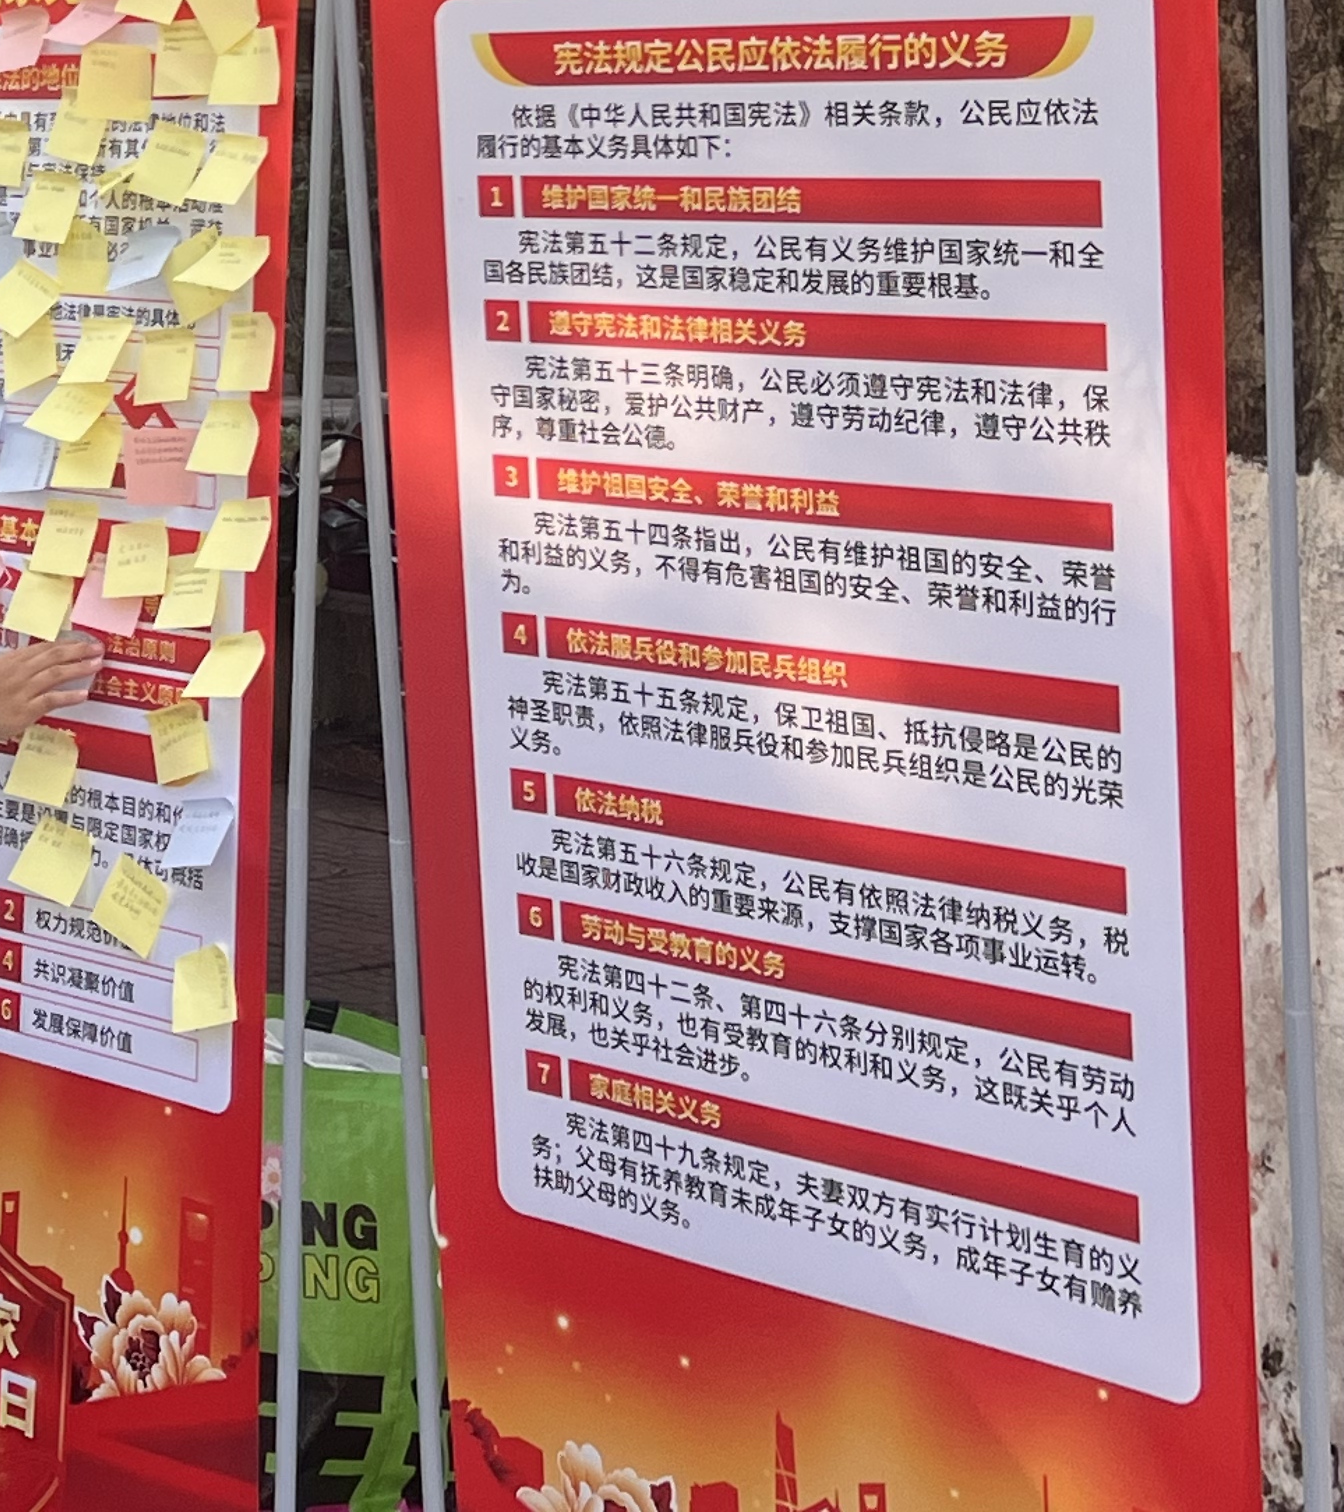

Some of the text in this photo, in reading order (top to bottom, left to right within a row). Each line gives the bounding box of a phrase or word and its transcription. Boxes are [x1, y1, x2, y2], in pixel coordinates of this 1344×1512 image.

[553, 30, 1009, 76] 宪法规定公民应依法履行的义务
[511, 97, 1100, 129] 依据《中华人民共和国宪法》相关条款，公民应依法
[475, 132, 734, 161] 履行的基本义务具体如下：
[489, 184, 802, 215] 1 维护国家统一和民族团结
[483, 259, 993, 301] 国各民族团结，这是国家稳定和发展的重要根基。
[517, 228, 1106, 271] 宪法第五十二条规定，公民有义务维护国家统一和全
[495, 310, 808, 348] 2 遵守宪法和法律相关义务
[524, 353, 1111, 413] 宪法第五十三条明确，公民必须遵守宪法和法律，保
[490, 383, 1111, 449] 守国家秘密，爱护公共财产，遵守劳动纪律，遵守公共秩
[490, 413, 677, 452] 序，尊重社会公德。
[504, 464, 840, 516] 3 维护祖国安全、荣誉和利益
[497, 537, 1116, 628] 和利益的义务，不得有危害祖国的安全、荣誉和利益的行
[500, 565, 534, 597] 为。
[533, 511, 1116, 593] 宪法第五十四条指出，公民有维护祖国的安全、荣誉
[512, 624, 849, 689] 4 依法服兵役和参加民兵组织
[507, 694, 1125, 809] 神圣职责，依照法律服兵役和参加民兵组织是公民的光荣
[509, 725, 565, 760] 义务。
[542, 669, 1122, 775] 宪法第五十五条规定，保卫祖国、抵抗侵略是公民的
[520, 779, 664, 827] 5 依法纳税
[3, 899, 16, 922] 2
[515, 851, 1099, 986] 收是国家财政收入的重要来源，支撑国家各项事业运转。
[550, 827, 1130, 960] 宪法第五十六条规定，公民有依照法律纳税义务，税
[527, 904, 786, 980] 6 劳动与受教育的义务
[1, 949, 135, 1004] 4 共识凝聚价值
[0, 998, 133, 1056] 6 发展保障价值
[523, 1008, 753, 1084] 发展，也关乎社会进步。
[556, 953, 1136, 1103] 宪法第四十二条、第四十六条分别规定，公民有劳动
[522, 978, 1137, 1139] 的权利和义务，也有受教育的权利和义务，这既关乎个人
[535, 1061, 723, 1130] 7 家庭相关义务
[531, 1132, 1143, 1319] 务；父母有抚养教育未成年子女的义务，成年子女有赡养
[532, 1165, 693, 1231] 扶助父母的义务。
[564, 1110, 1141, 1287] 宪法第四十九条规定，夫妻双方有实行计划生育的义
